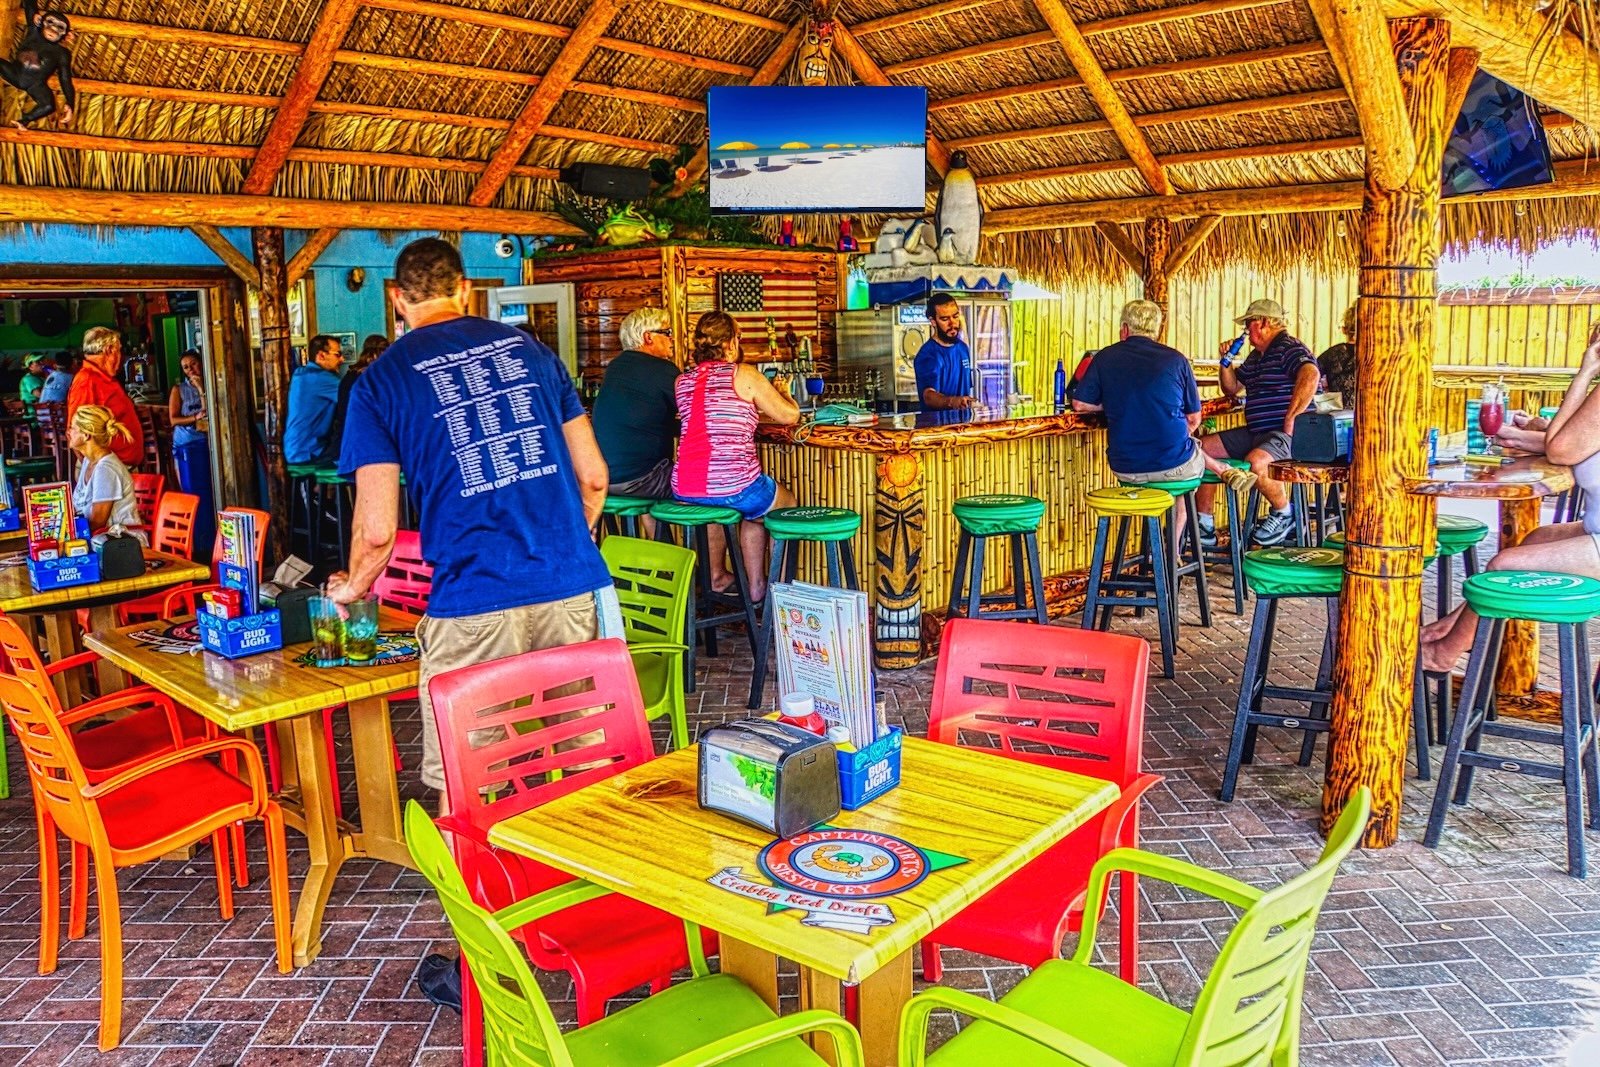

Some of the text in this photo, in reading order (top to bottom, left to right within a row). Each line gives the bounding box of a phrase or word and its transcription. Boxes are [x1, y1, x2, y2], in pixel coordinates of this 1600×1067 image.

[460, 482, 494, 498] CAPTAIN
[541, 464, 558, 475] KEY
[56, 572, 82, 582] LIGHT
[59, 567, 77, 576] BUD
[240, 634, 271, 649] LIGHT
[243, 628, 266, 640] BUD
[814, 700, 840, 714] CLAM
[868, 758, 889, 780] BUD
[864, 766, 893, 793] LIGHT
[789, 831, 882, 847] CAPTAIN
[770, 862, 872, 894] SIESTA KEY
[720, 876, 882, 916] Crabby Red Draft
